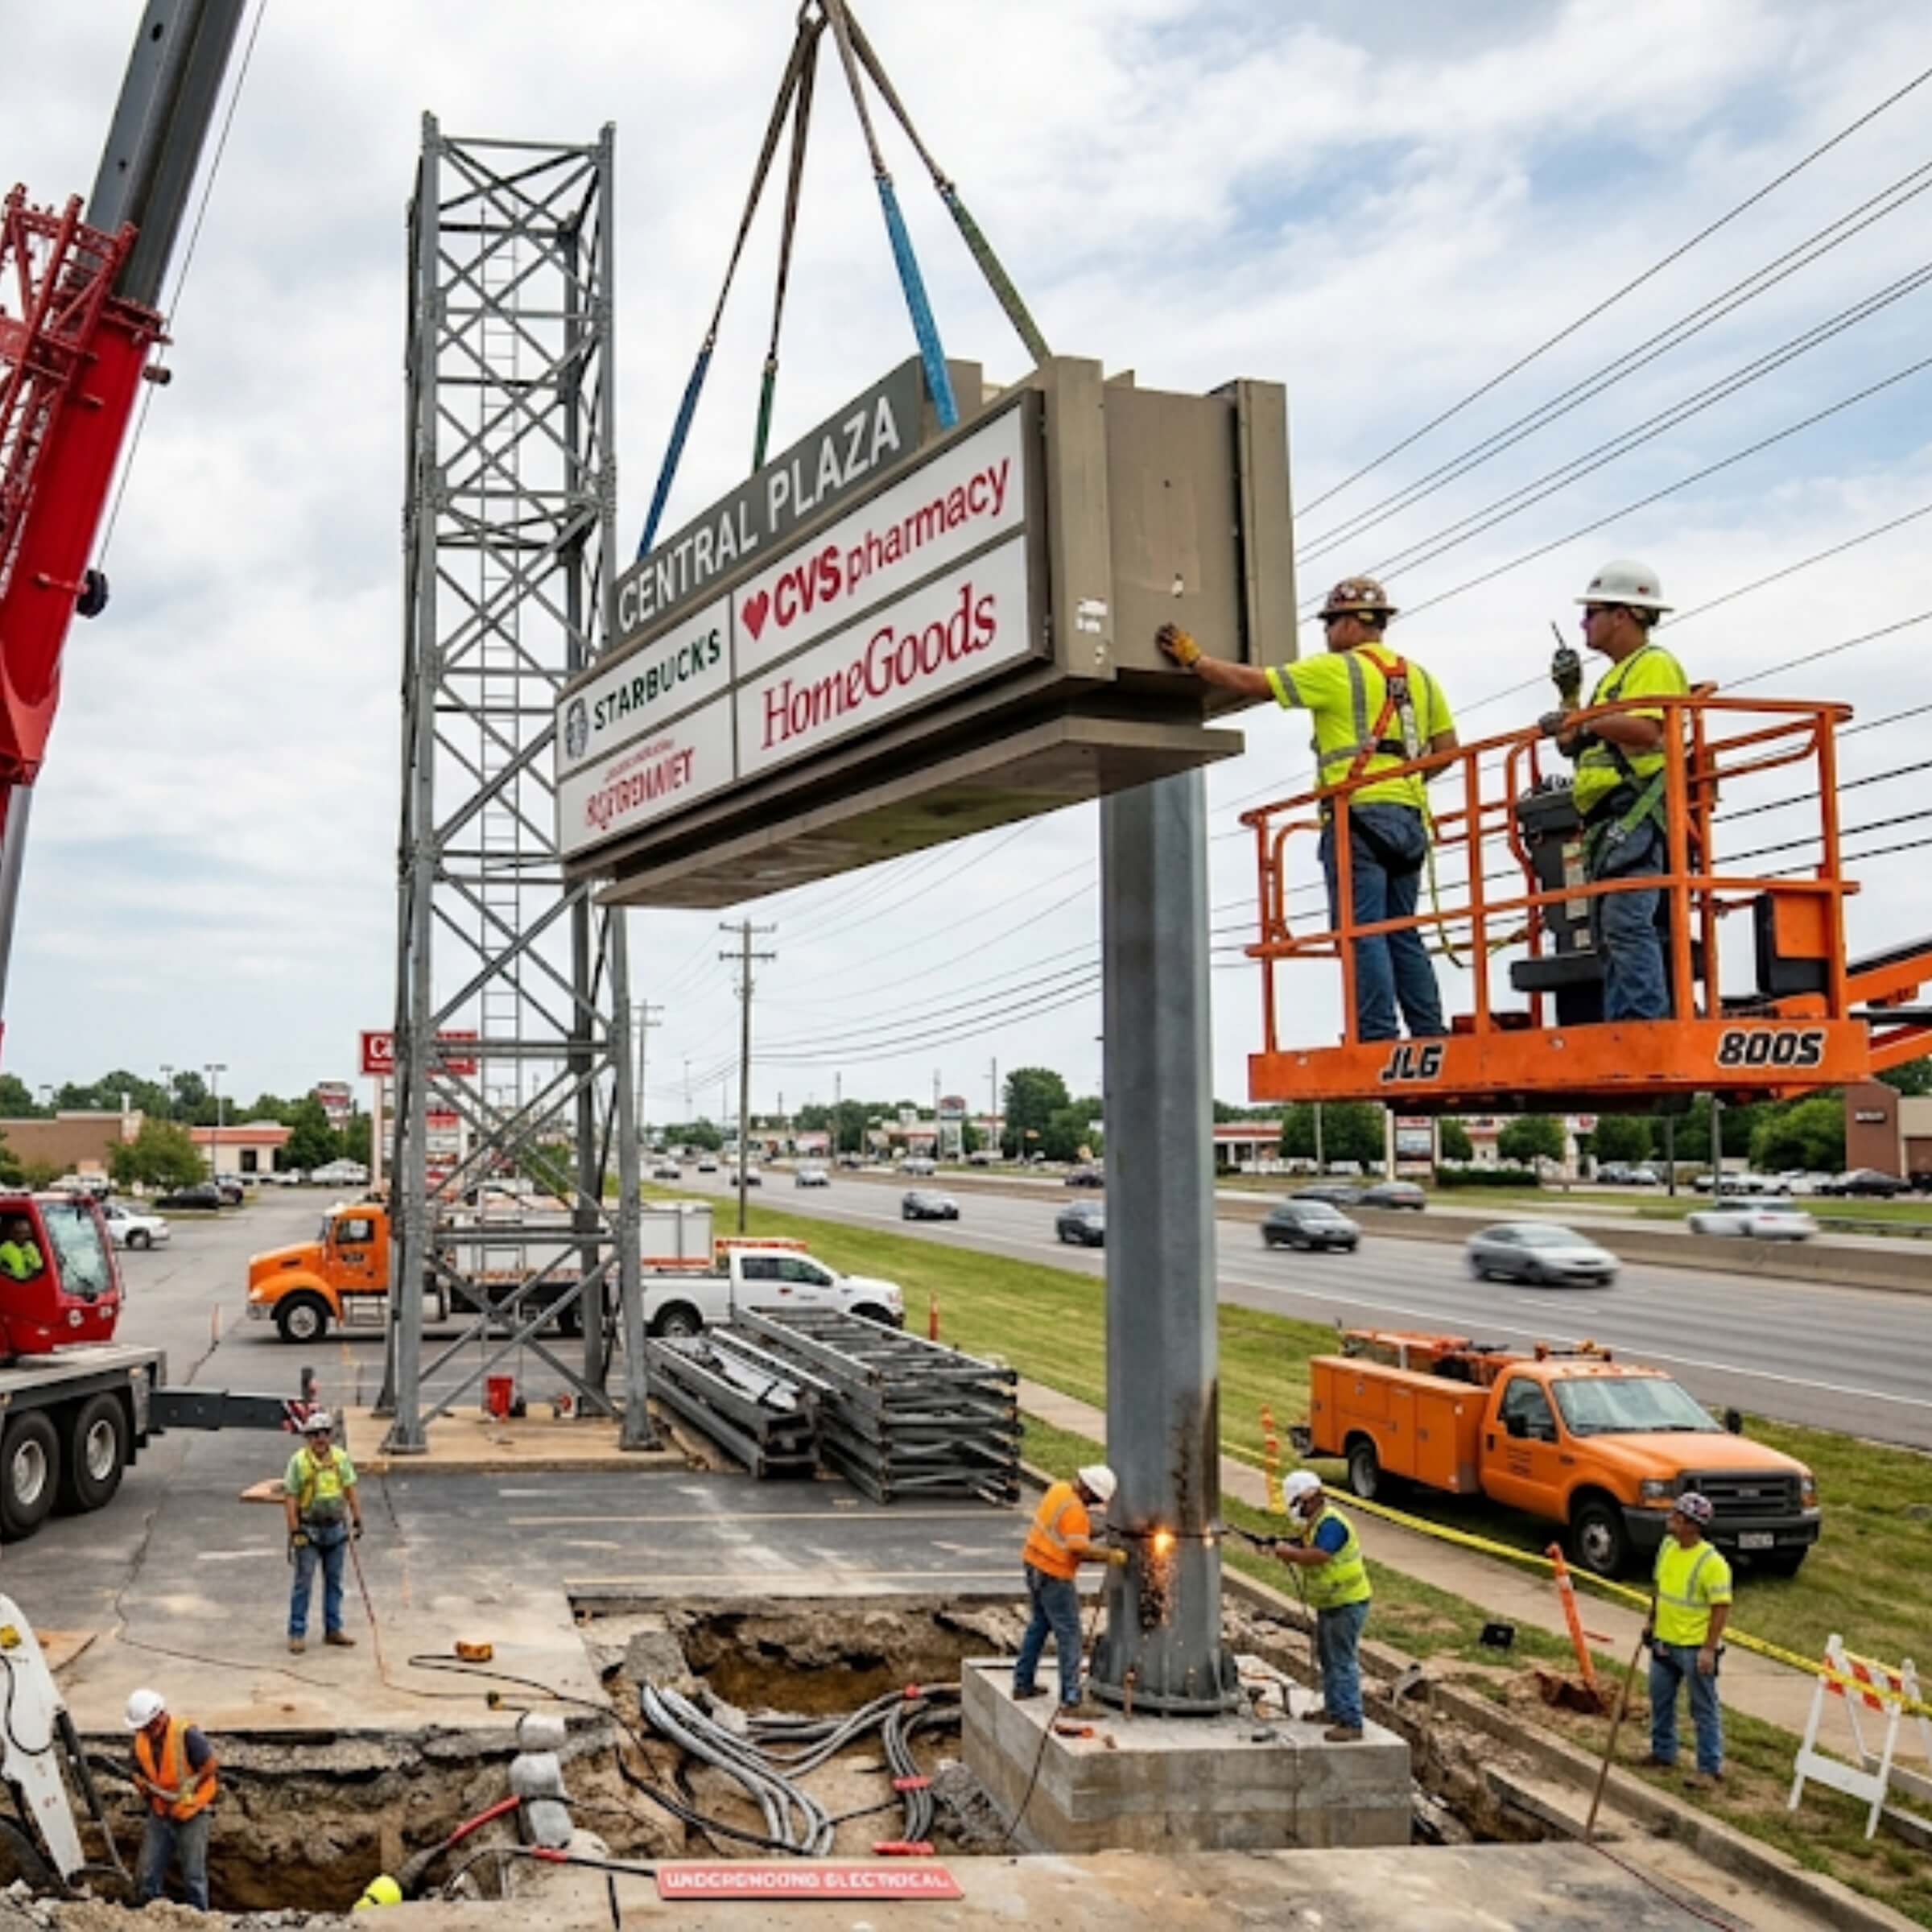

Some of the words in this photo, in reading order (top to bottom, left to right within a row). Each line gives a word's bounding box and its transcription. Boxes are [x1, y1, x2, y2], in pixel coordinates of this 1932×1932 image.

[618, 502, 758, 632] CENTRAL
[767, 394, 901, 531] PLAZA
[773, 544, 841, 629] CVS
[846, 458, 1009, 593] pharmacy
[593, 628, 721, 732] STARBUCKS
[762, 583, 997, 749] HomeGoods
[1382, 1045, 1443, 1080] JLG
[1718, 1031, 1824, 1066] 800S
